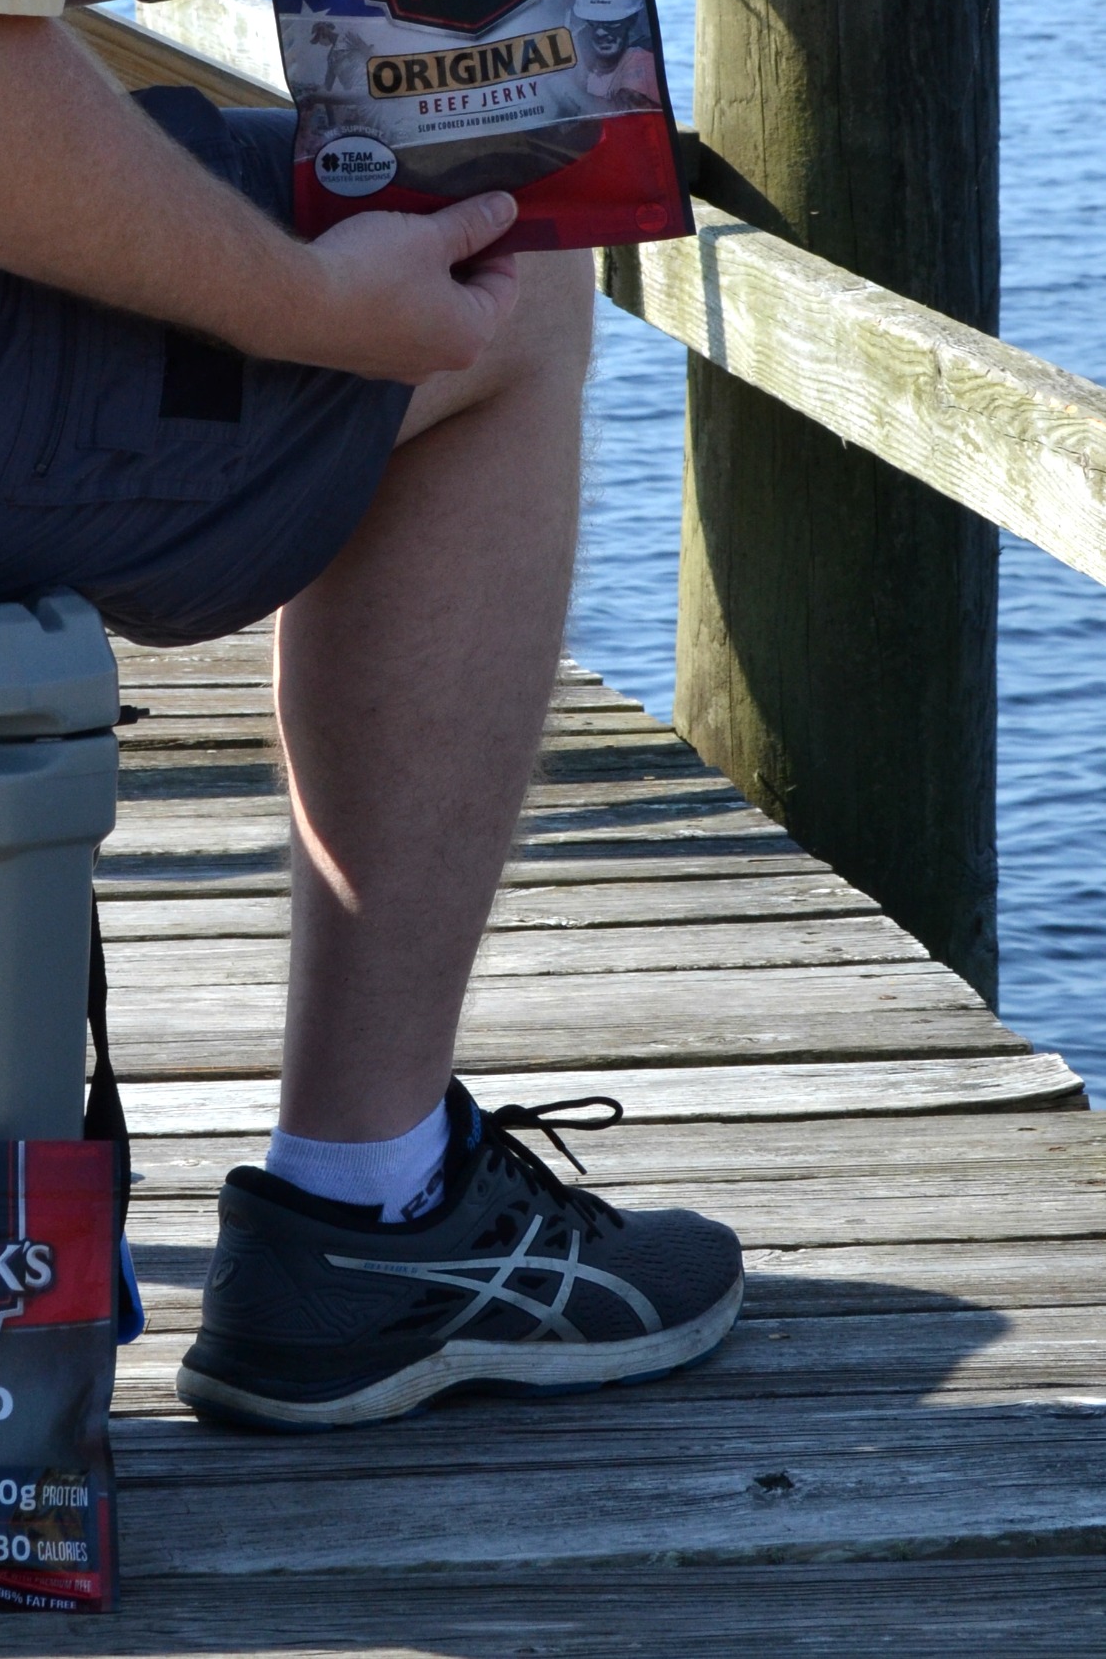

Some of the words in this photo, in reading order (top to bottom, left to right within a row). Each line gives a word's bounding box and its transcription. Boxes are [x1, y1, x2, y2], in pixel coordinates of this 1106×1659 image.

[373, 34, 572, 93] ORIGINAL
[419, 95, 470, 114] BEEF
[481, 81, 538, 107] JERKY
[418, 124, 436, 133] SLOW
[438, 120, 464, 131] COOKED
[466, 118, 480, 127] AND
[481, 111, 518, 125] HARDWOOD
[519, 106, 545, 119] SMOKED
[341, 124, 385, 138] SUPPORT
[341, 152, 373, 162] TEAM
[355, 173, 391, 182] RESPONSE
[42, 1485, 88, 1507] PROTEIN
[37, 1540, 88, 1562] CALORIES
[26, 1594, 47, 1608] FAT
[50, 1598, 78, 1610] FREE
